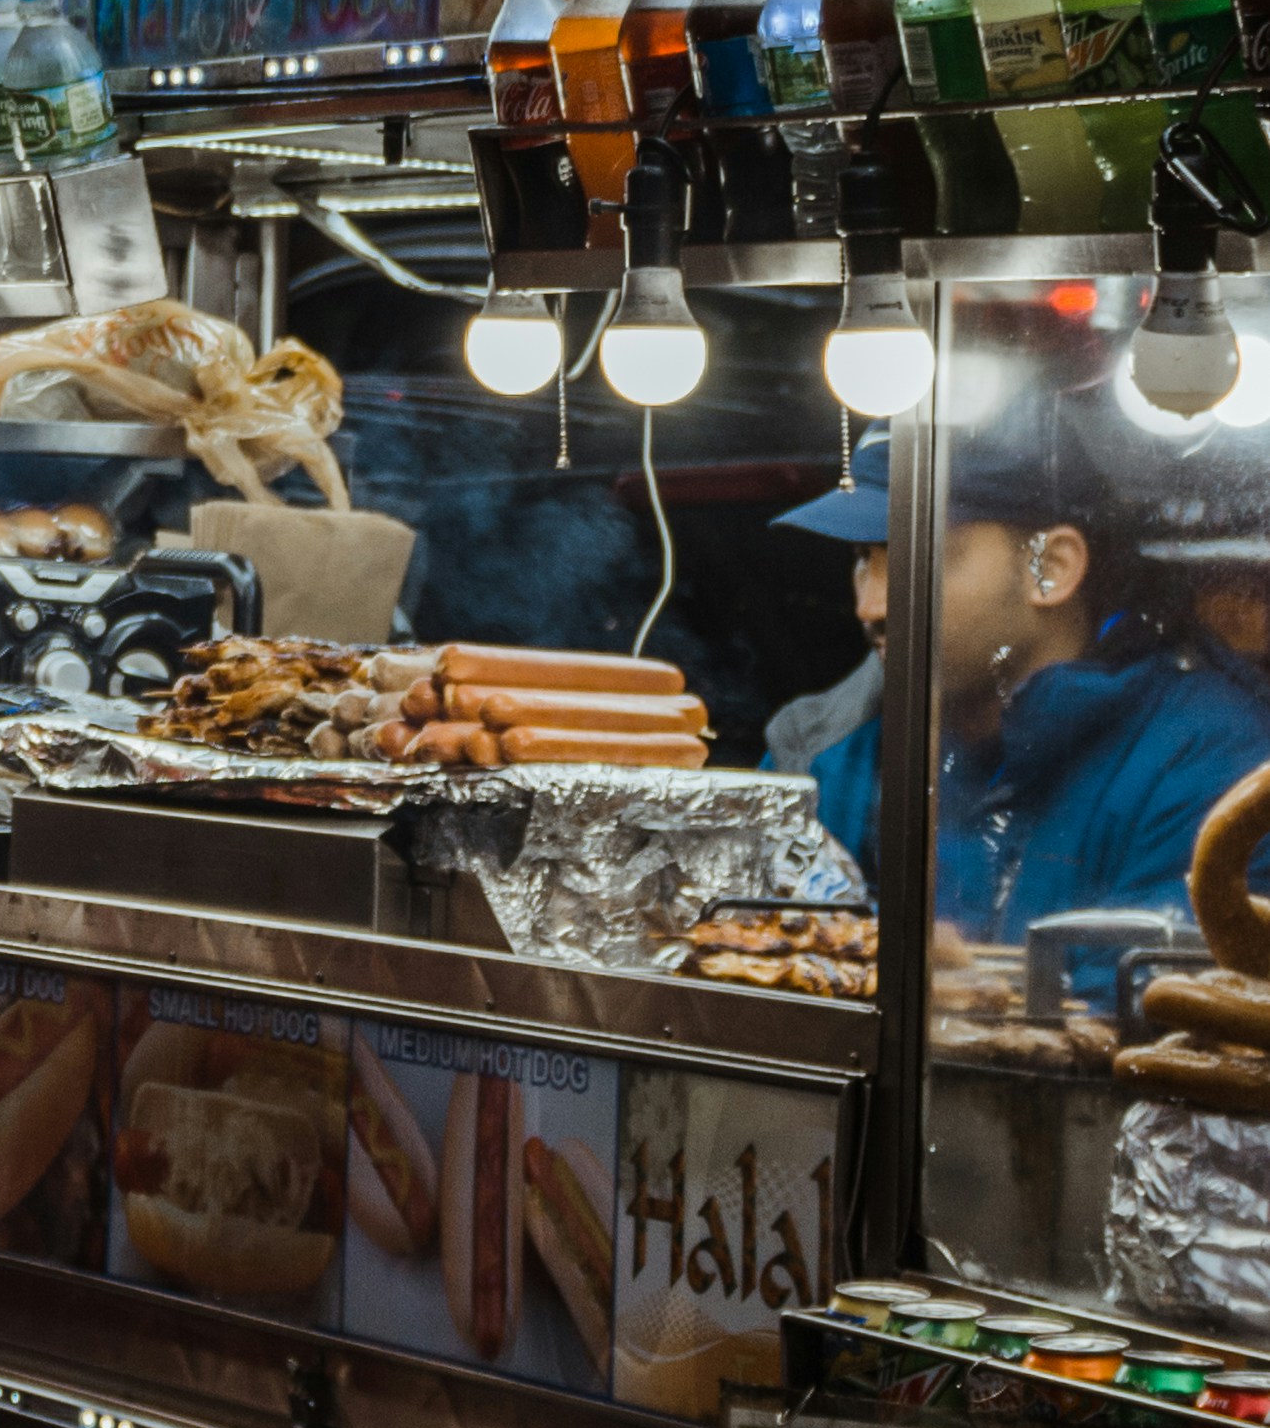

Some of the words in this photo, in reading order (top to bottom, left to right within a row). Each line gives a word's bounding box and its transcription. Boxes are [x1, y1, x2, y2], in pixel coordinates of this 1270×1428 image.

[22, 967, 66, 1003] DOG
[147, 989, 220, 1029] SMALL
[223, 998, 268, 1035] HOT
[270, 1005, 319, 1044] DOG
[378, 1024, 473, 1073] MEDIUM
[477, 1043, 530, 1082] HOT
[533, 1051, 590, 1093] DOG
[626, 1138, 831, 1309] Halal
